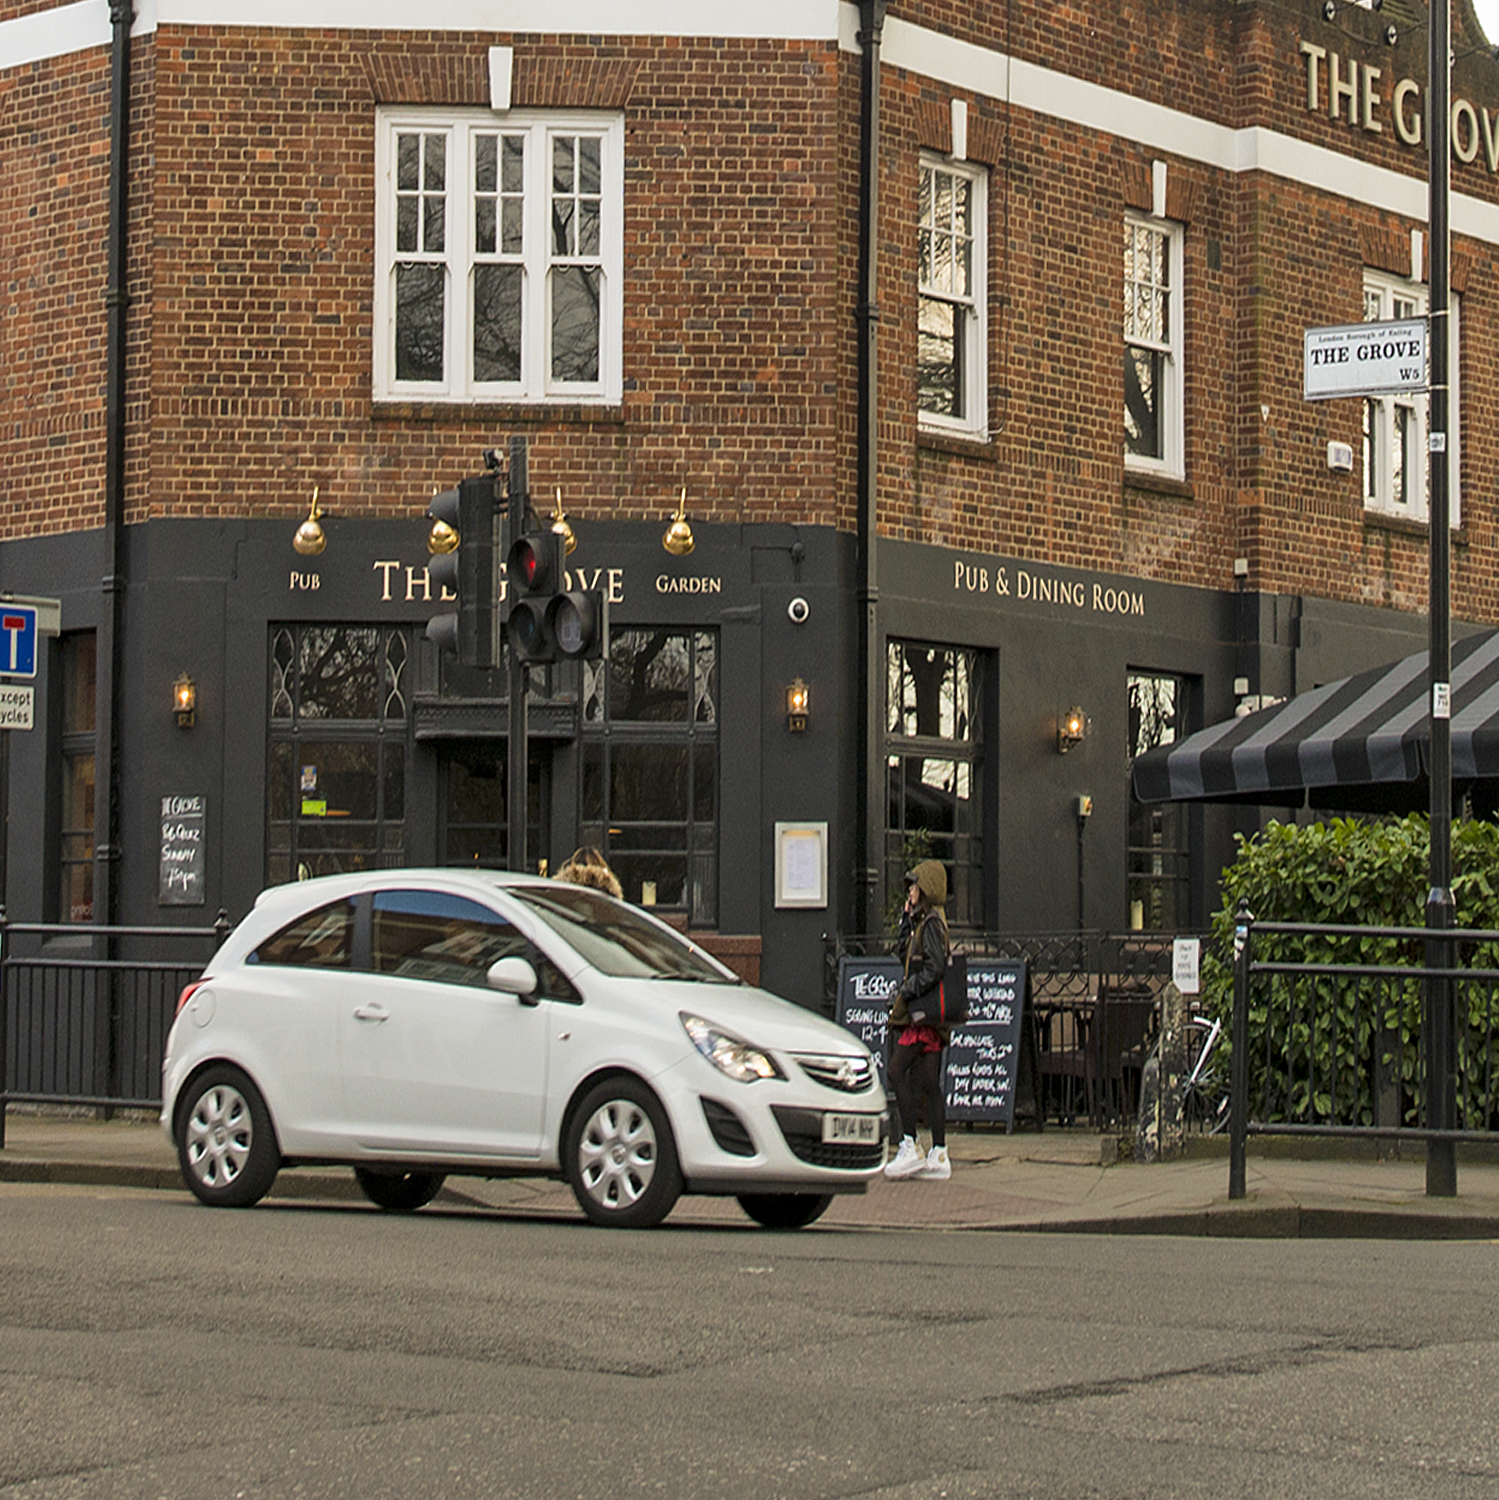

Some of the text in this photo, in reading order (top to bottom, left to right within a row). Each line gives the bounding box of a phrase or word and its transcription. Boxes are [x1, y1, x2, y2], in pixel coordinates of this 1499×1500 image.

[1300, 40, 1383, 133] THE
[1346, 332, 1376, 342] Borough
[1388, 329, 1412, 338] Ealing
[1311, 340, 1420, 366] THE GROVE
[1399, 368, 1419, 381] W5
[995, 566, 1011, 596] &
